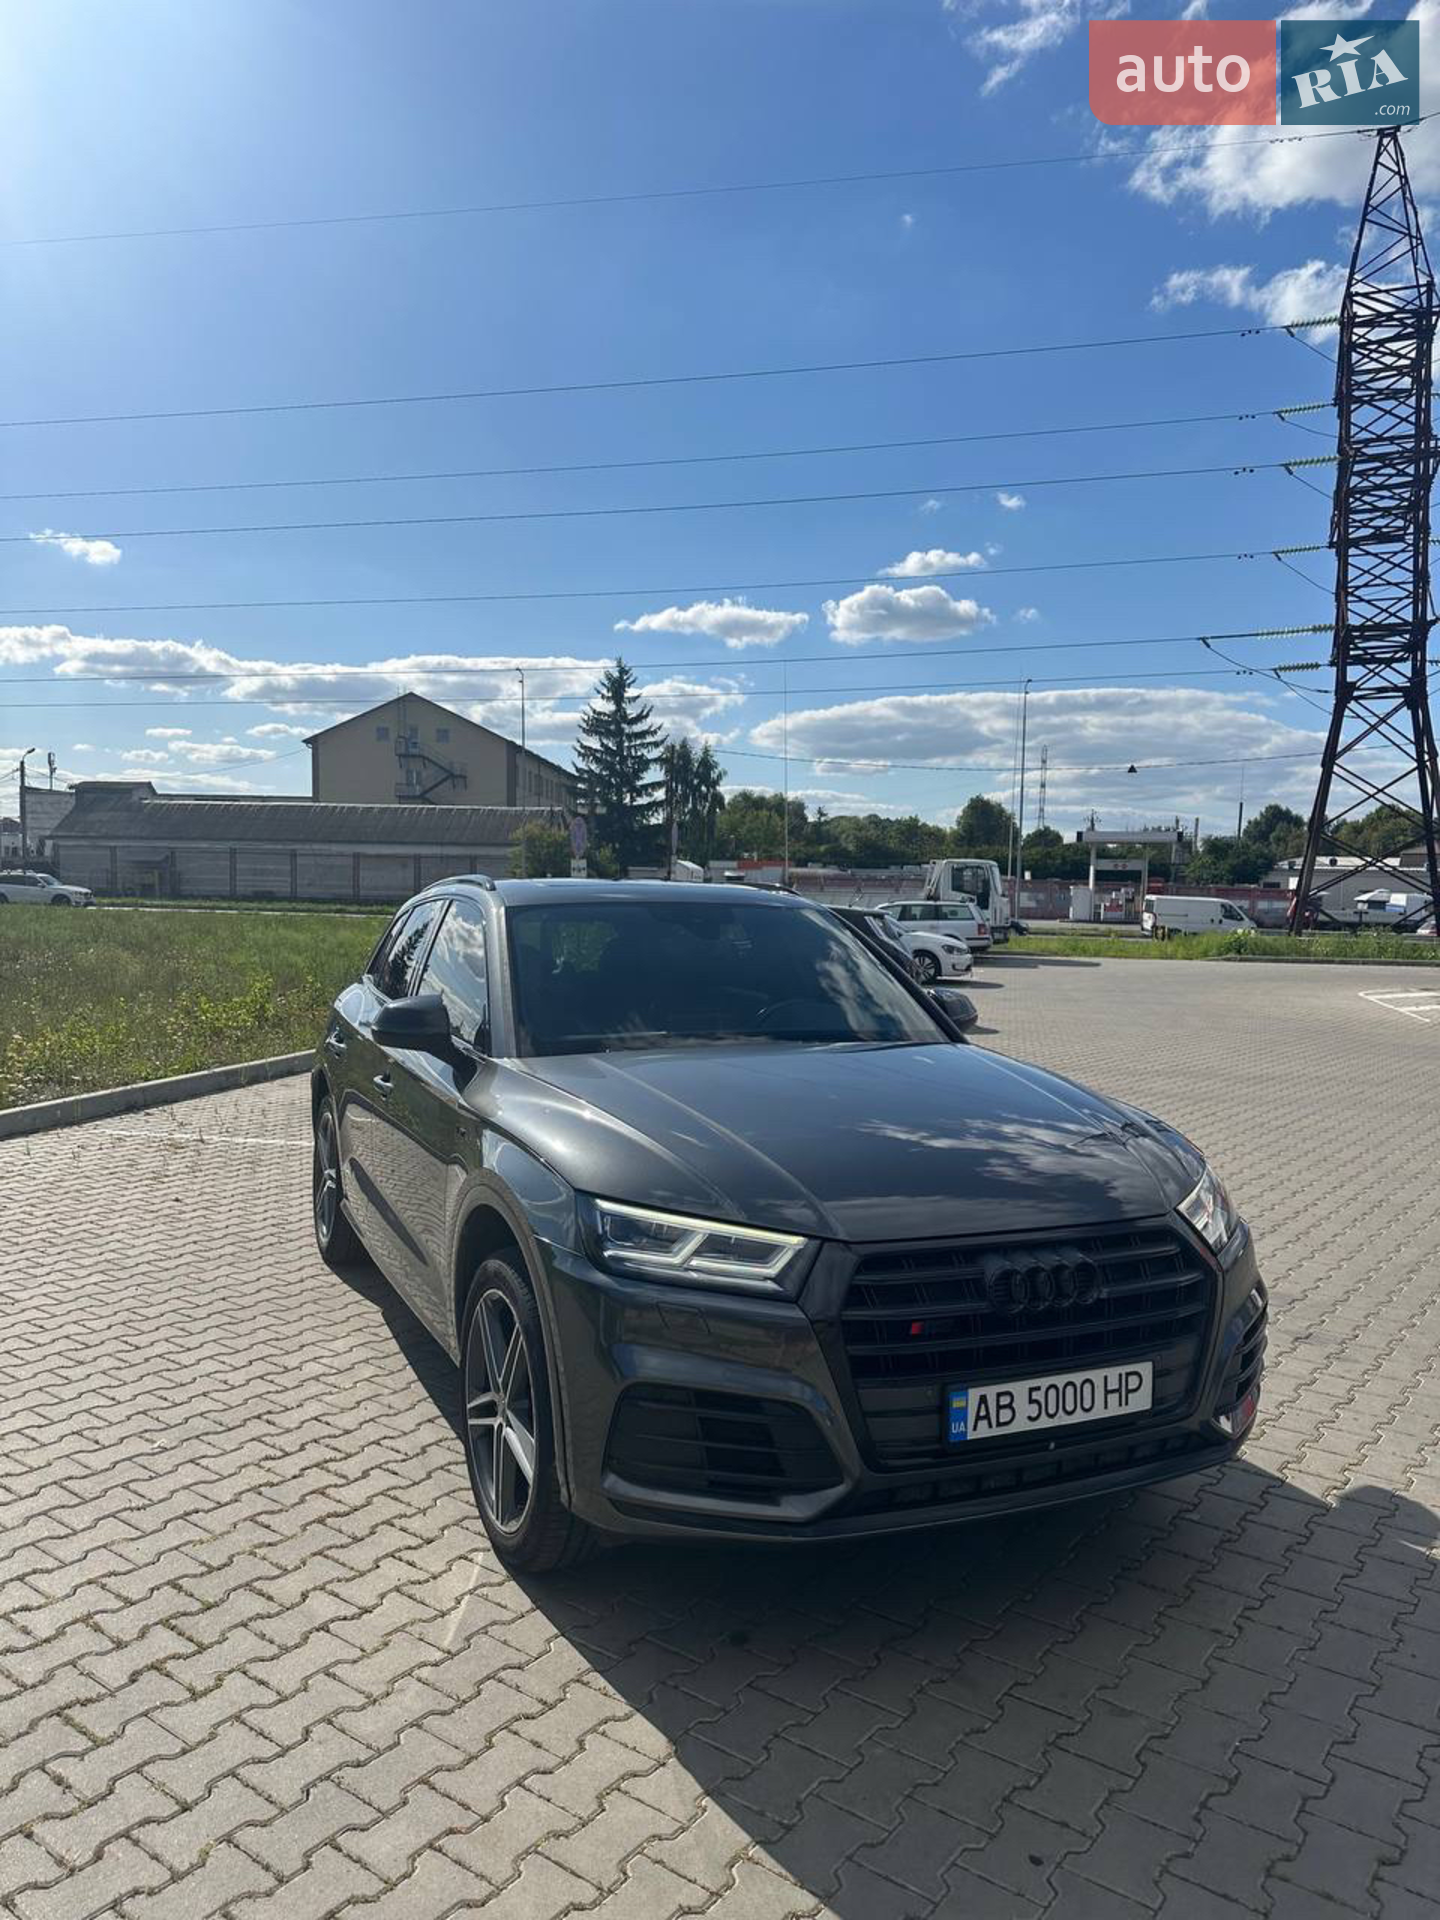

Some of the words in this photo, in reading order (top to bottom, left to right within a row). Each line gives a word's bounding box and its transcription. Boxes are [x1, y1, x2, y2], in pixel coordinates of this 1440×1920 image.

[972, 1390, 1017, 1432] AB
[1027, 1378, 1096, 1423] 5000
[1103, 1370, 1144, 1411] HP
[951, 1421, 967, 1434] UA
